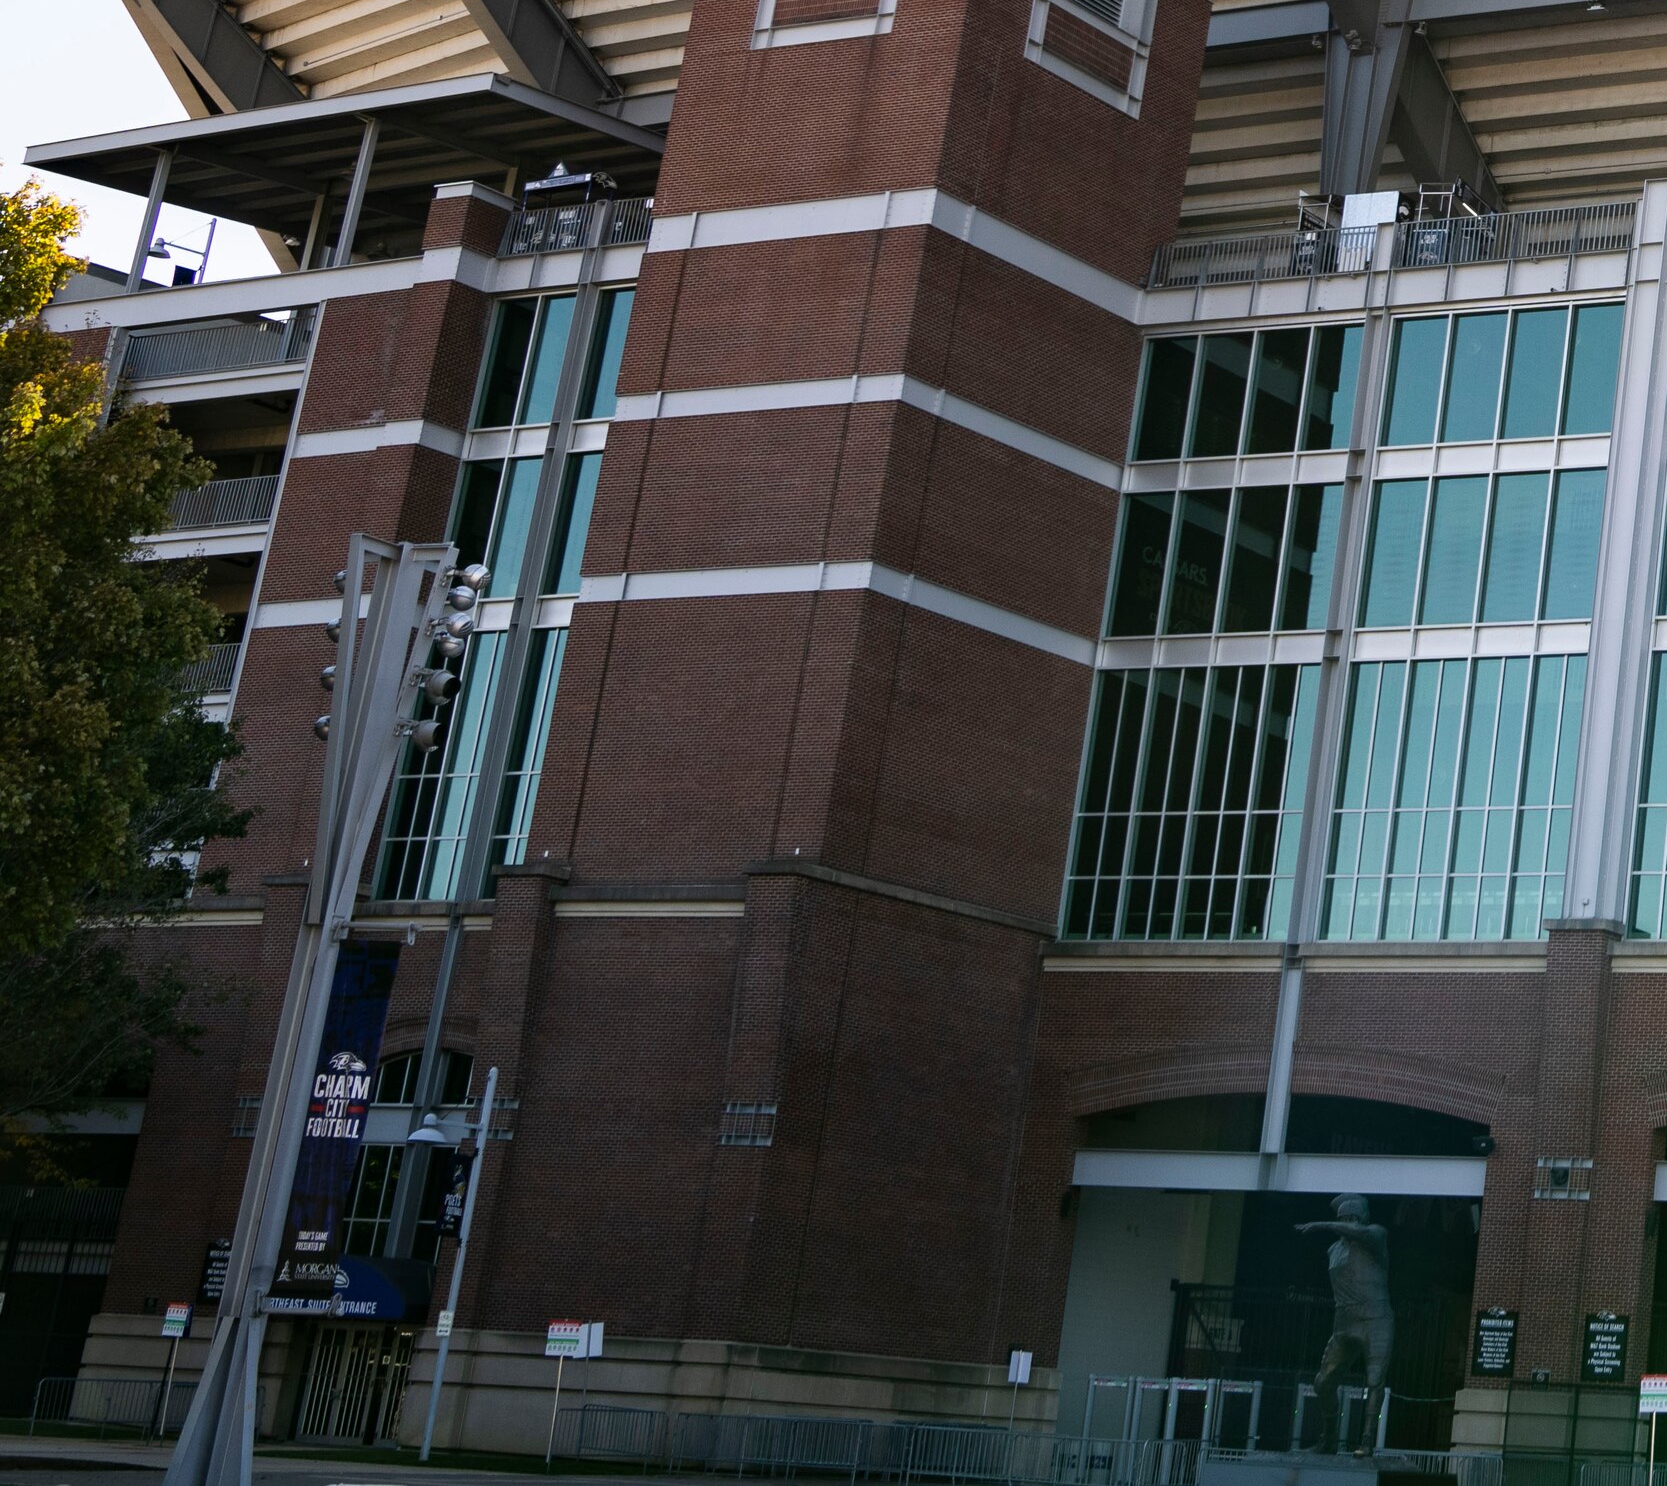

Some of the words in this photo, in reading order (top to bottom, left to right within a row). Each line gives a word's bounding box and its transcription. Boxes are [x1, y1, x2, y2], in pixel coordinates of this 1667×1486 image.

[1141, 545, 1208, 587] CAARS
[314, 1074, 371, 1100] CHARM
[295, 1262, 339, 1275] MORGAN
[270, 1297, 305, 1310] RTHEAST
[339, 1301, 377, 1315] NTRANCE
